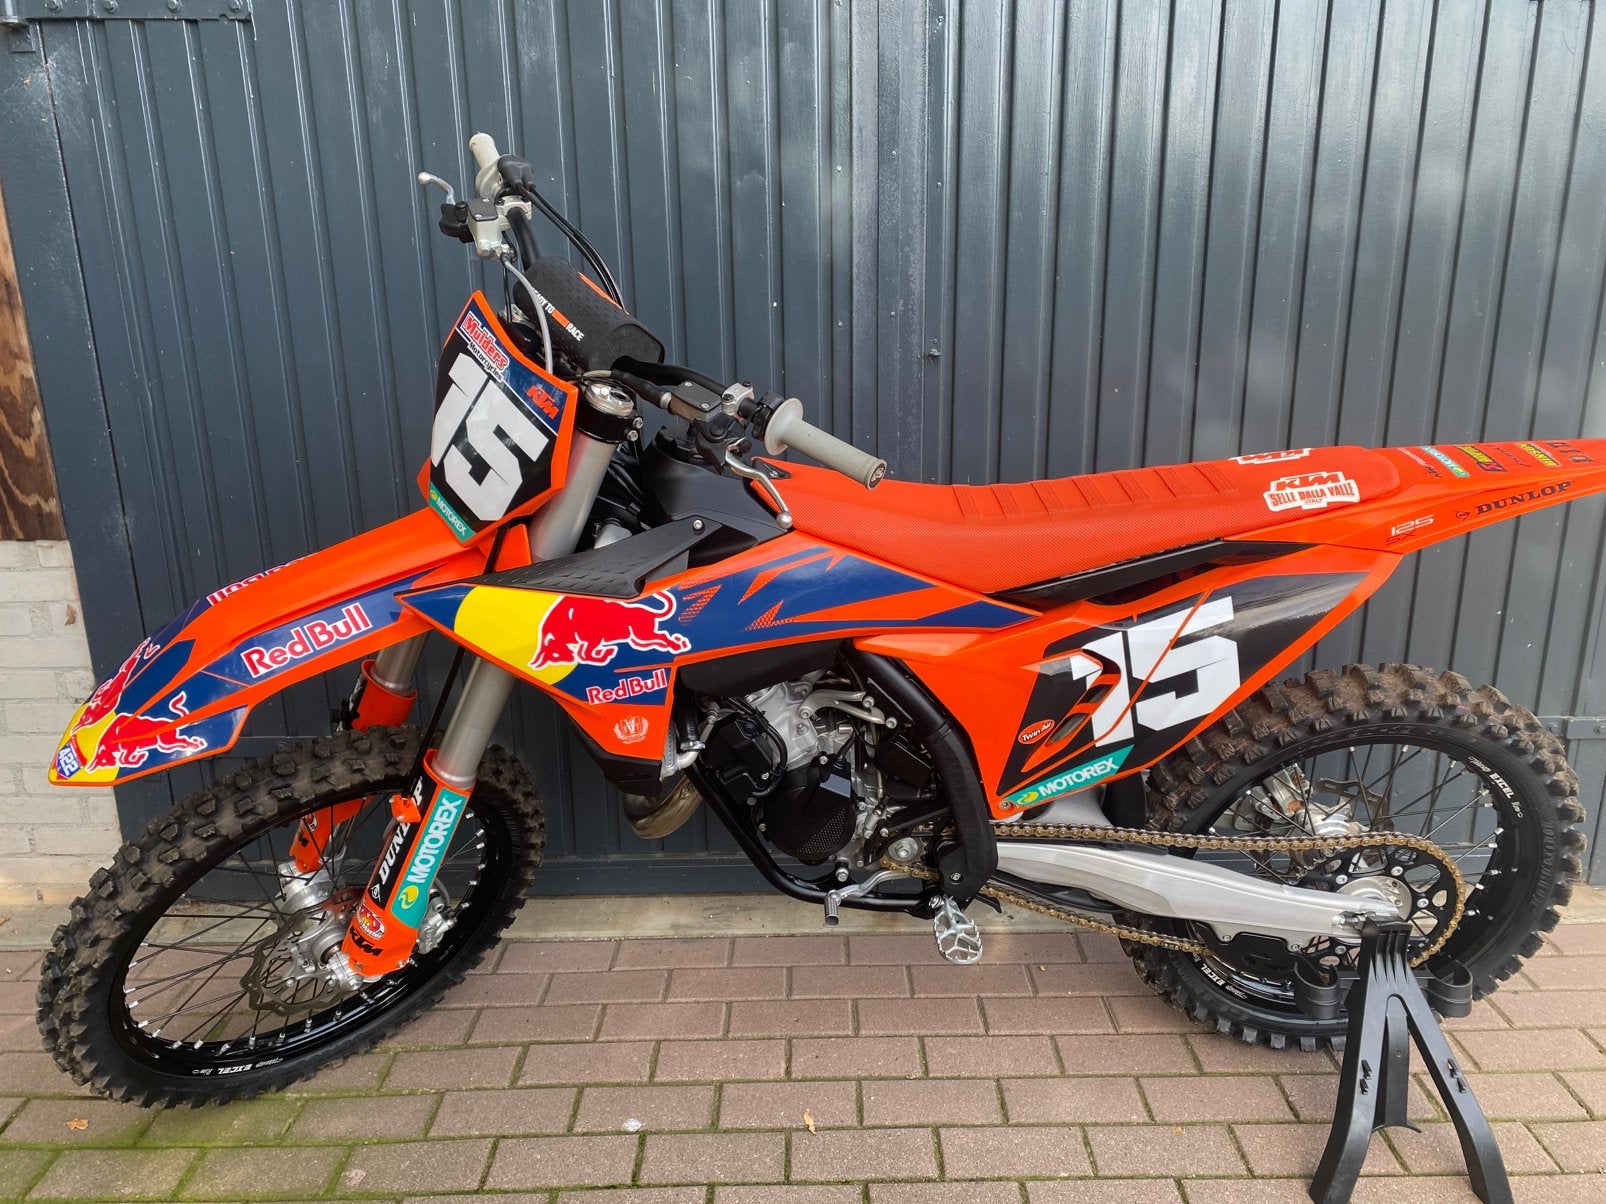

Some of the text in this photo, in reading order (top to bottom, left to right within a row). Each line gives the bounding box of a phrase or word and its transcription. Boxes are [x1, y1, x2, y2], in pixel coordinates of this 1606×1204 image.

[545, 302, 585, 342] TO RACE
[461, 312, 509, 372] Mulders
[468, 341, 502, 381] Motorcycles
[526, 385, 560, 419] KTM
[431, 352, 549, 521] 15
[1269, 482, 1355, 507] SELLE DALLA VALLE
[1276, 472, 1341, 491] KTM
[1475, 480, 1572, 515] DUNLOP
[435, 498, 466, 536] MOTOREX
[1390, 514, 1434, 536] 125
[1385, 530, 1416, 545] SX
[240, 603, 373, 678] Red Bull
[586, 669, 667, 705] Red Bull
[1070, 596, 1241, 748] 15
[1022, 721, 1053, 741] Twin Air
[1038, 756, 1120, 798] MOTOREX
[1489, 772, 1515, 799] EXCEL
[406, 795, 464, 884] MOTOREX
[350, 925, 385, 957] KTM
[1201, 963, 1225, 986] EXCEL
[217, 1064, 253, 1075] EXCEL
